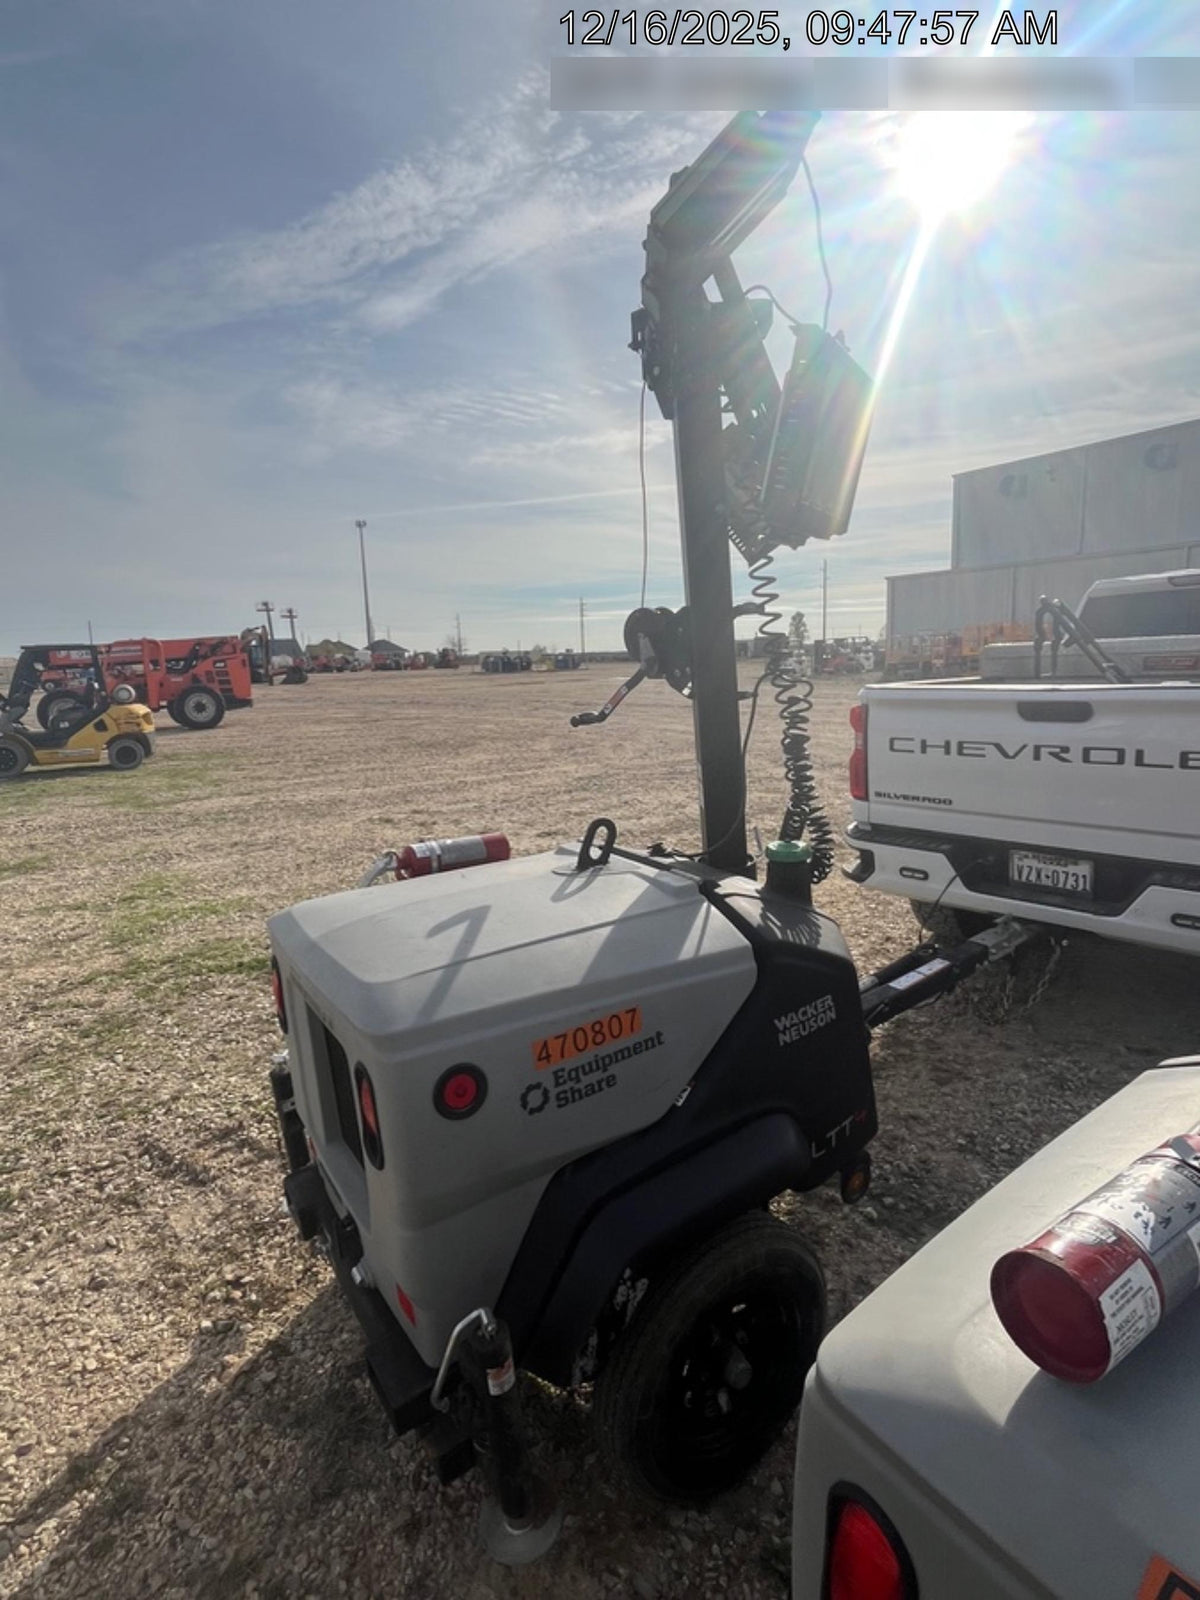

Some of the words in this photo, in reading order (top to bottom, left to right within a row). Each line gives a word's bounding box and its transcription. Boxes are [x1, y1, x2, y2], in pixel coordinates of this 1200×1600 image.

[873, 790, 953, 806] SILVERADO
[773, 994, 834, 1031] WACKER
[778, 1006, 837, 1046] NEUSON
[536, 1008, 638, 1065] 470807
[552, 1030, 664, 1088] Equipment
[555, 1072, 617, 1109] Share
